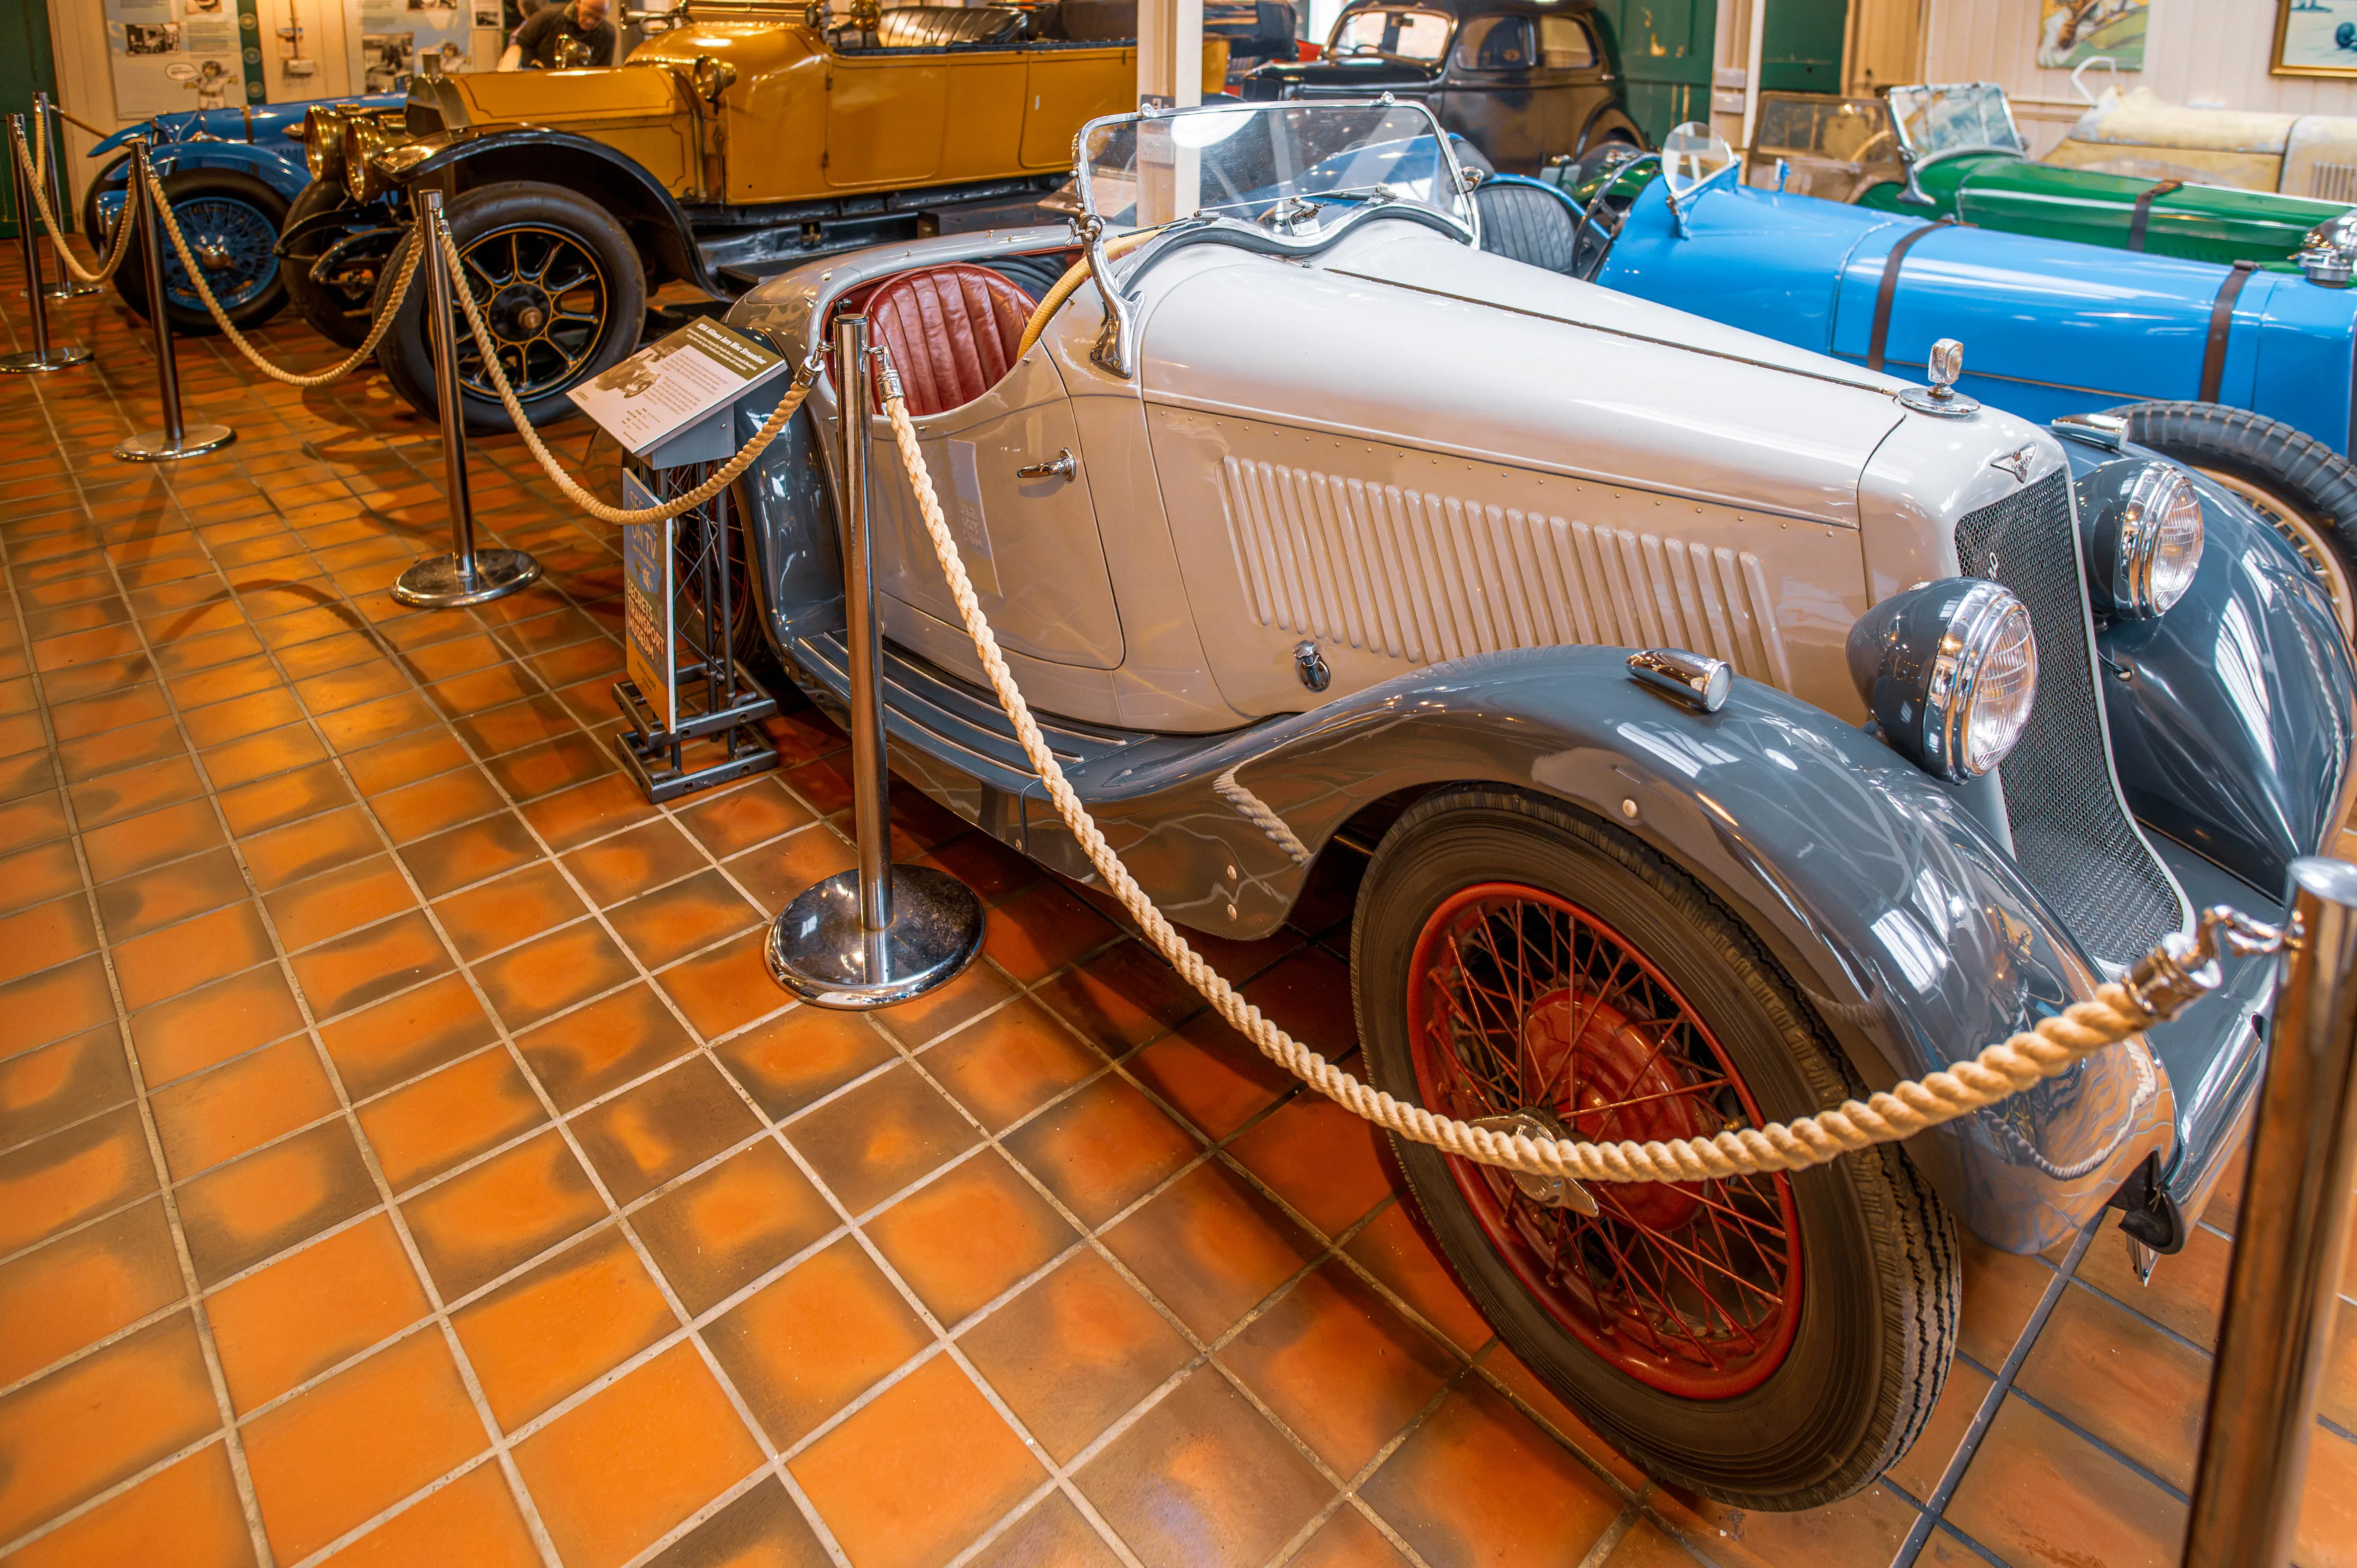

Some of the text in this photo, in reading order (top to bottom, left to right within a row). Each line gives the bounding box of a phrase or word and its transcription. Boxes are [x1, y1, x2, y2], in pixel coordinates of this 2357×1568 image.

[705, 328, 722, 339] Hillman
[730, 342, 742, 351] Minx
[740, 348, 766, 364] Streamliner
[631, 524, 657, 560] ON TV
[627, 578, 653, 622] SECRETS
[627, 594, 664, 655] TRANSPORT
[628, 612, 654, 660] MUSEUM
